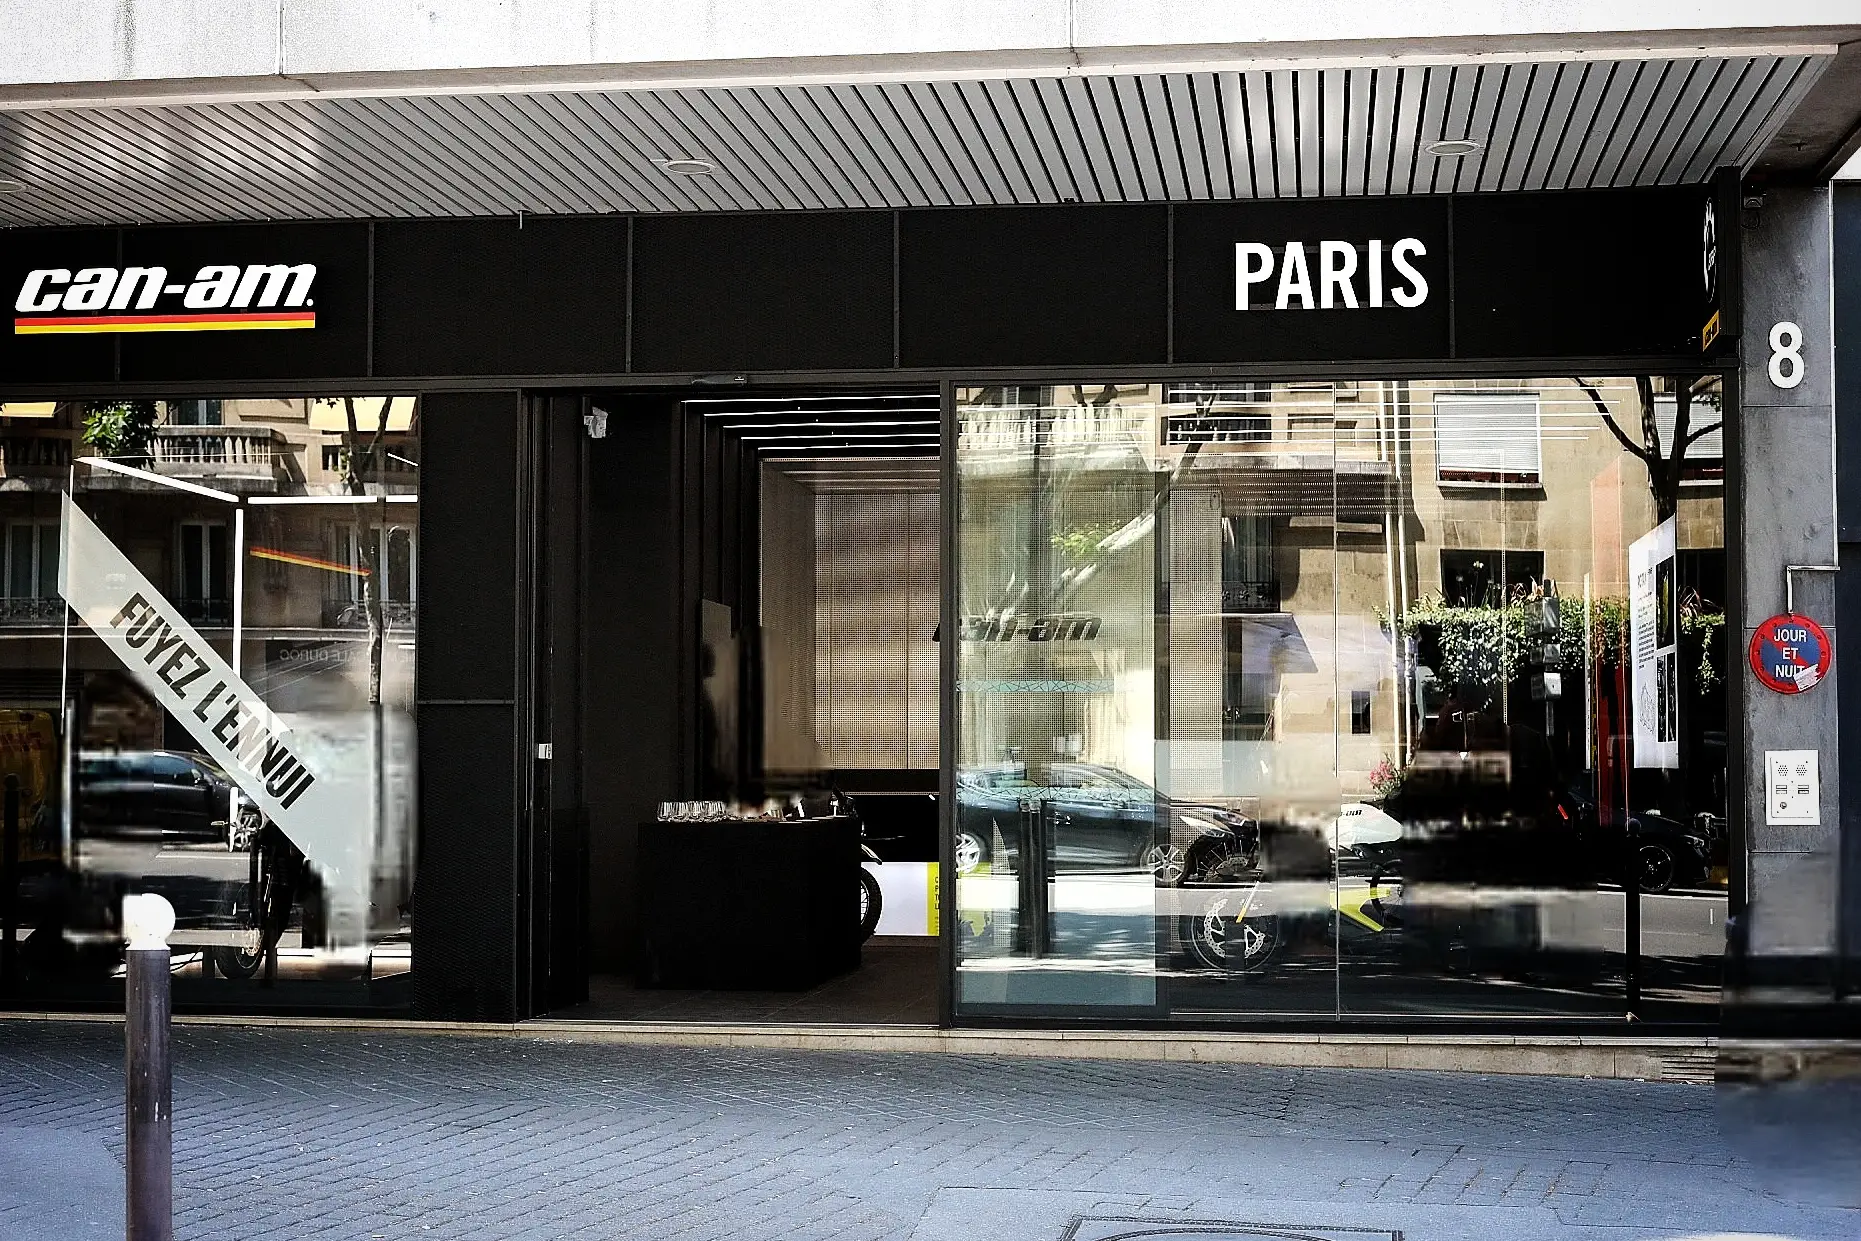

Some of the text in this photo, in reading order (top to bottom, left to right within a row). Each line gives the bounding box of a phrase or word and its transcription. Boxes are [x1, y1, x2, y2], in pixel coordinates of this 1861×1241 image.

[1235, 237, 1429, 311] PARIS
[1768, 321, 1805, 389] 8
[1773, 628, 1807, 643] JOUR
[1782, 647, 1798, 660] ET
[109, 592, 316, 810] FUYEZ L'ENNUI
